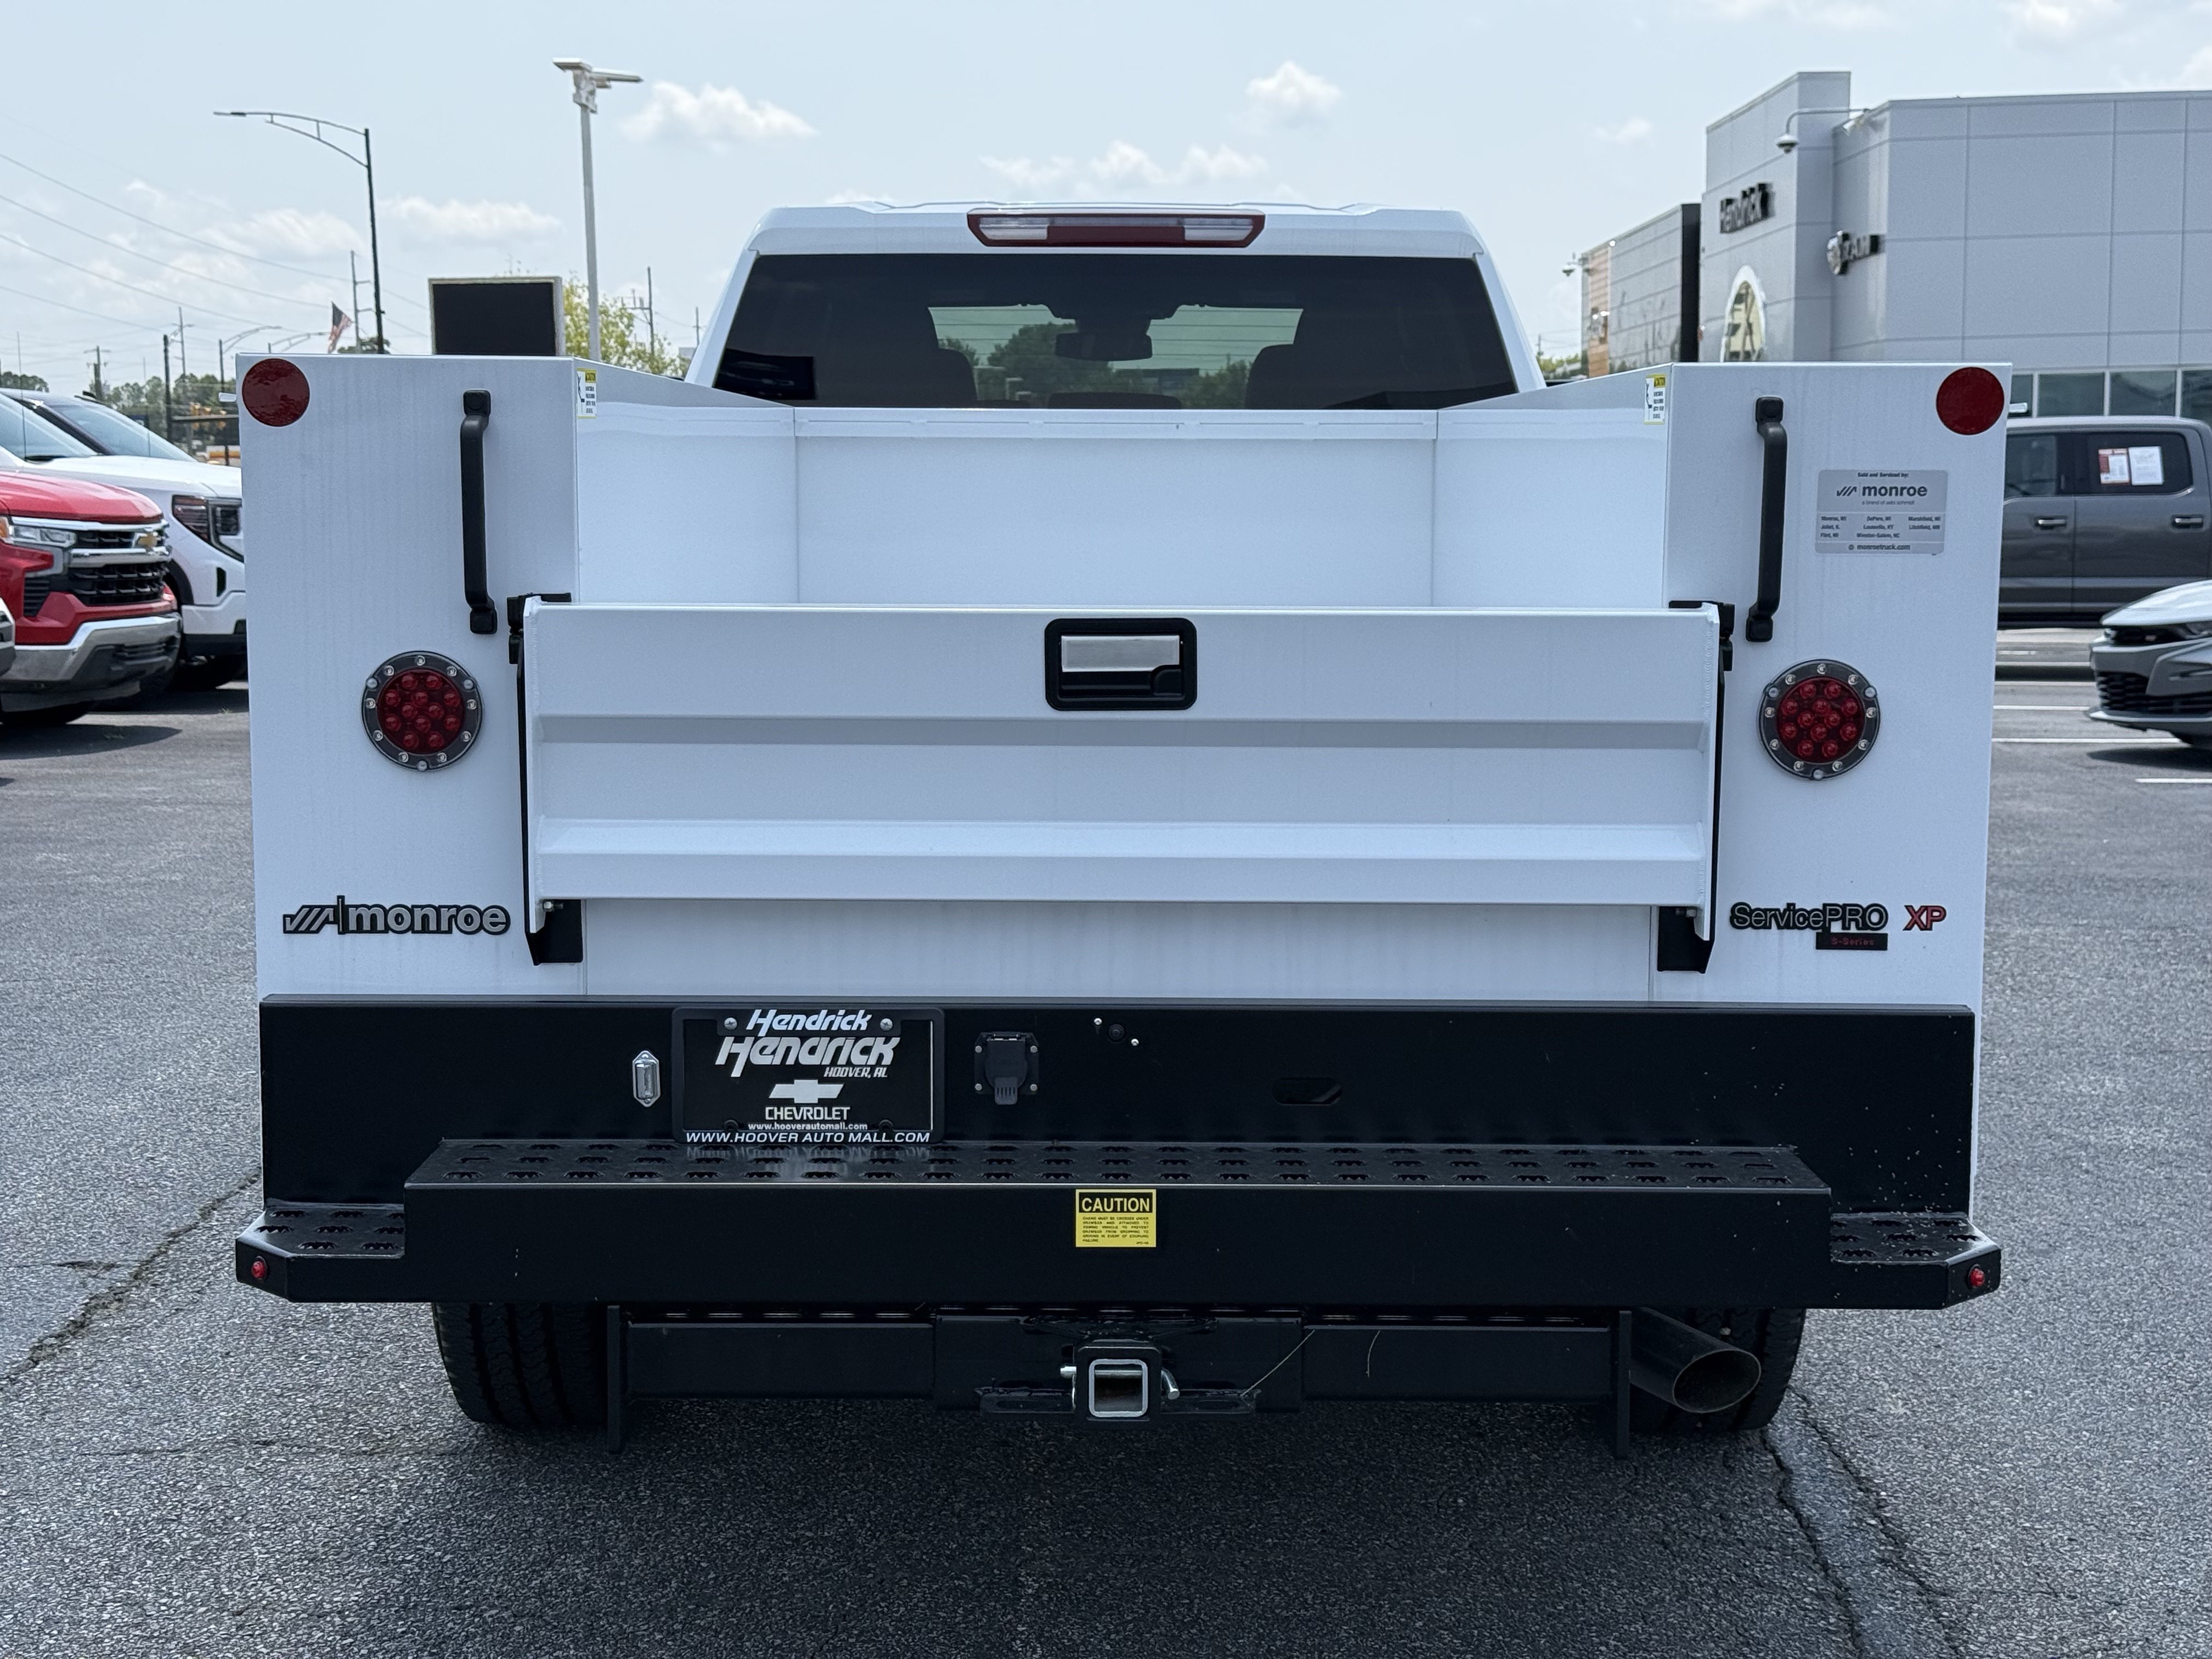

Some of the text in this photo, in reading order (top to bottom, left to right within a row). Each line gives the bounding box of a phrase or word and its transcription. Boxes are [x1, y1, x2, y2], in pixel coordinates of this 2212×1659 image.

[1862, 486, 1927, 496] monroe
[345, 904, 511, 934] monroe
[1730, 902, 1947, 931] ServicePRO XP
[1831, 937, 1875, 946] S-Series
[746, 1009, 873, 1036] Hendrick
[715, 1036, 901, 1078] Hendrick
[823, 1066, 888, 1079] HOOVER, AL
[765, 1107, 850, 1121] CHEVROLET
[748, 1122, 868, 1131] www.hooverautomall.com
[686, 1132, 930, 1143] WWW.HOOVER AUTO MALL.COM
[1081, 1198, 1150, 1212] CAUTION
